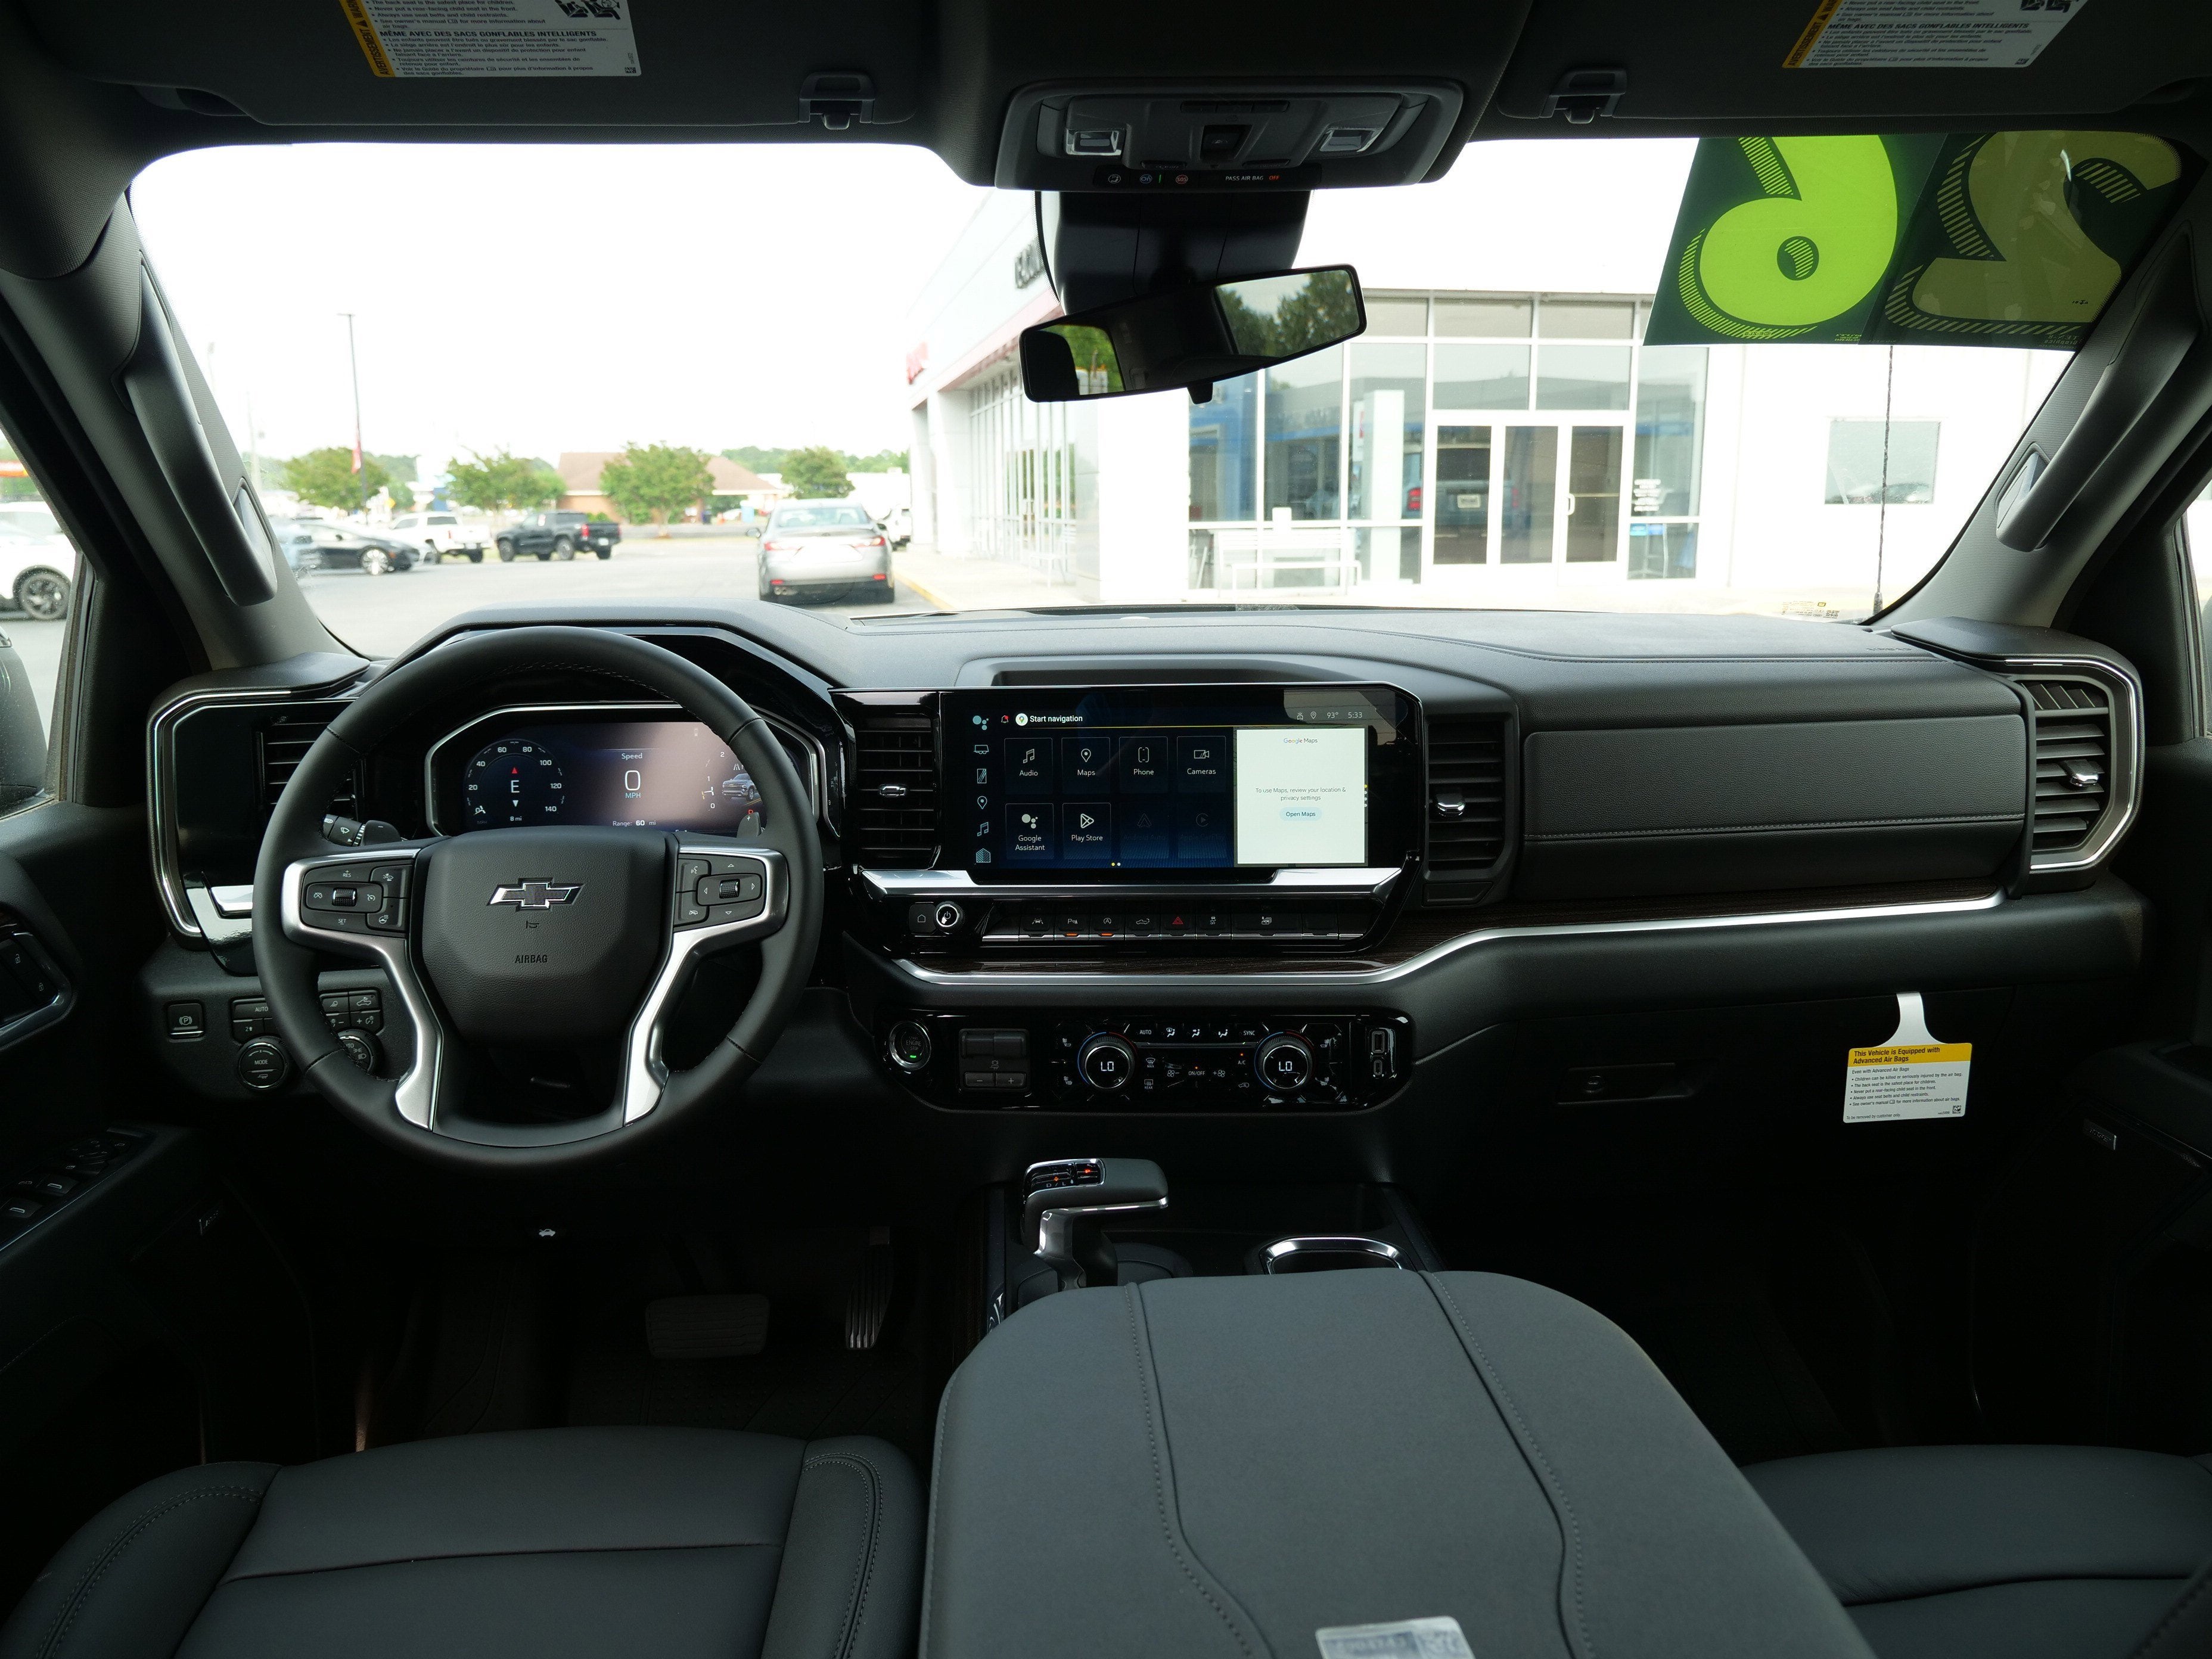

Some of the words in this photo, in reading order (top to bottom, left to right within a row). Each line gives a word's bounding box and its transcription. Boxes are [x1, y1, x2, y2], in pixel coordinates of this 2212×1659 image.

[359, 29, 390, 75] AVERTISSEMENT
[1048, 715, 1083, 723] navigation
[625, 770, 641, 791] 0
[511, 780, 520, 793] E
[1018, 835, 1042, 843] Google
[1071, 834, 1085, 843] Play
[515, 953, 548, 964] AIRBAG
[1101, 1061, 1114, 1071] LO
[1279, 1061, 1292, 1071] LO
